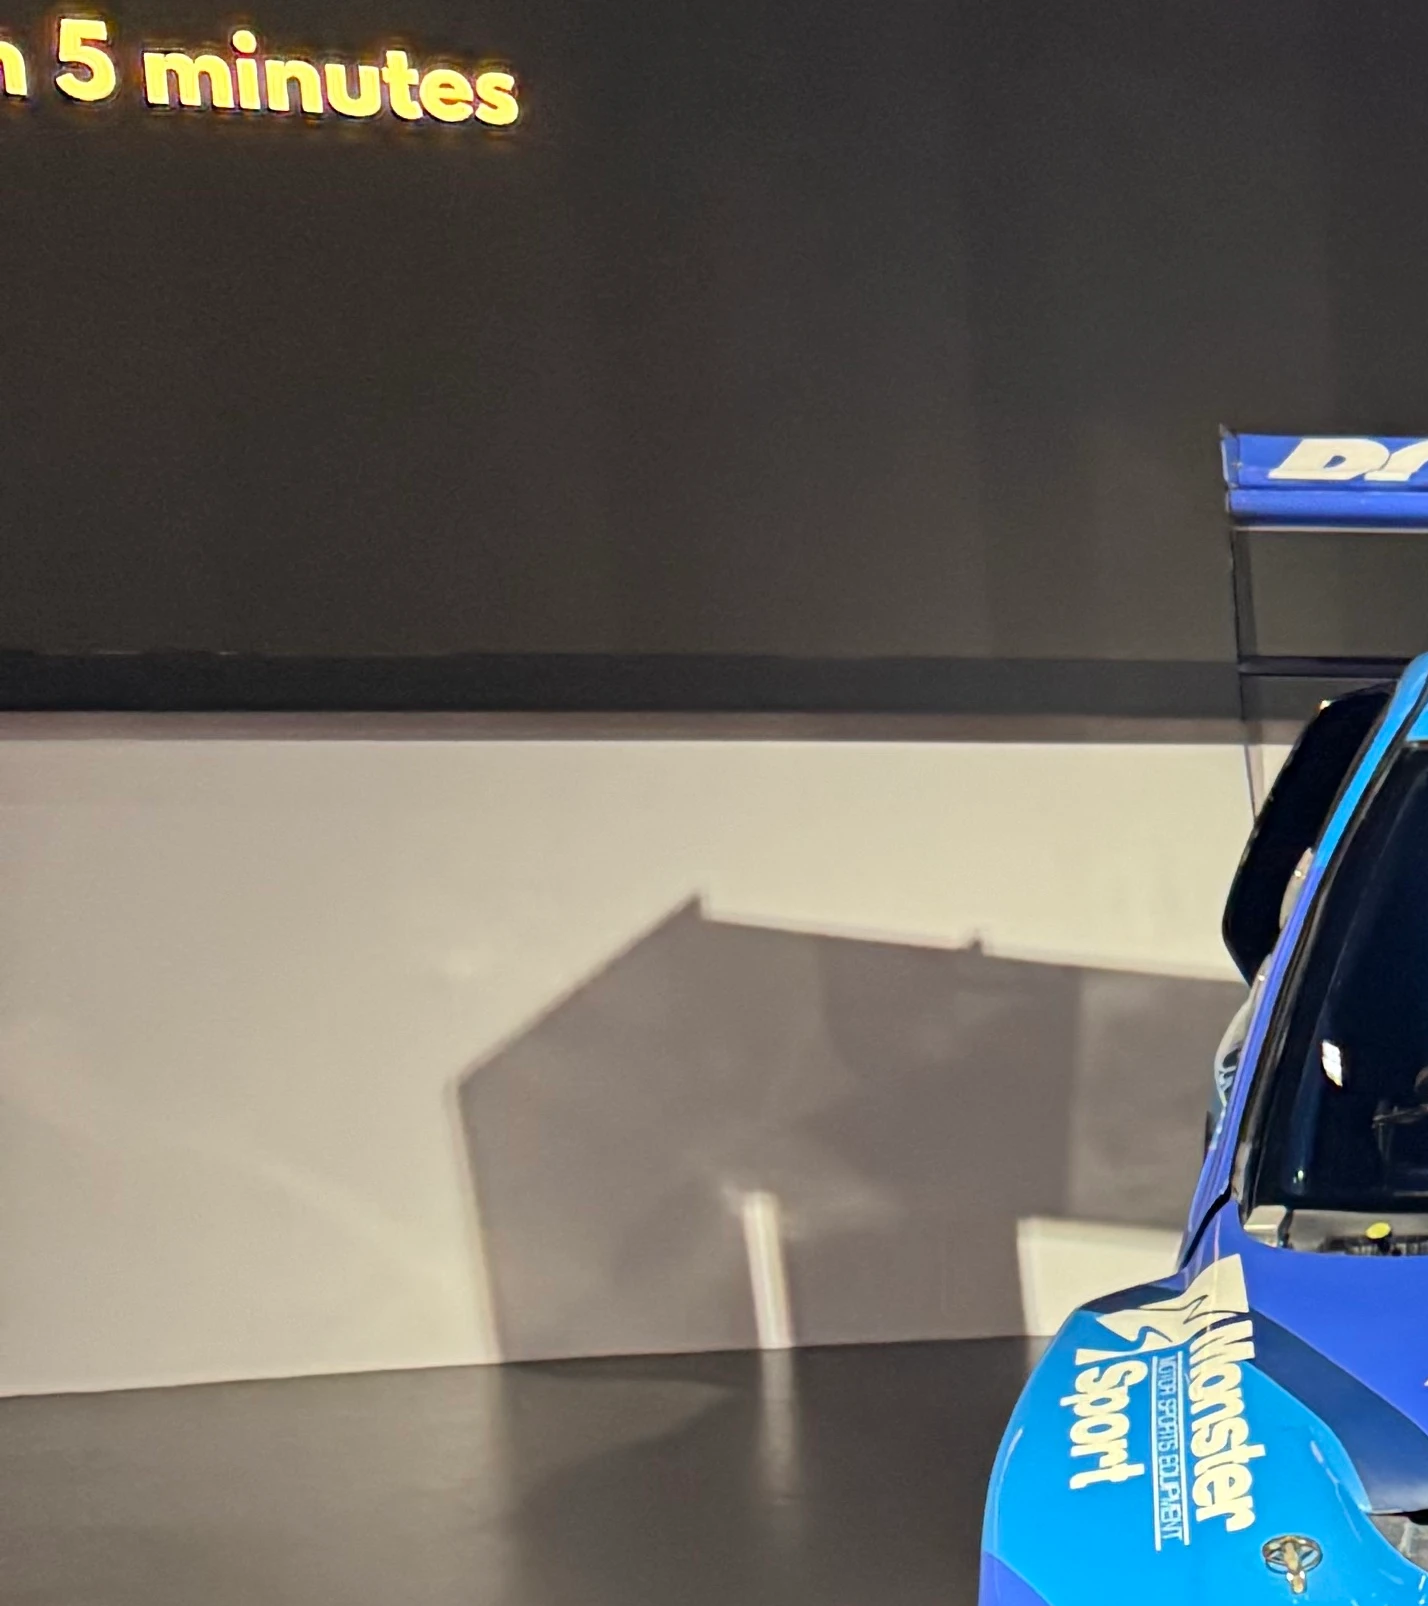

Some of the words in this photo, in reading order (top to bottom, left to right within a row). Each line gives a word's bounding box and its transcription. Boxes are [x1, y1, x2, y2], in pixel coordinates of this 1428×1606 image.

[56, 19, 116, 101] 5
[144, 30, 518, 125] minutes
[1059, 1360, 1148, 1490] Sport
[1187, 1320, 1266, 1533] Monster
